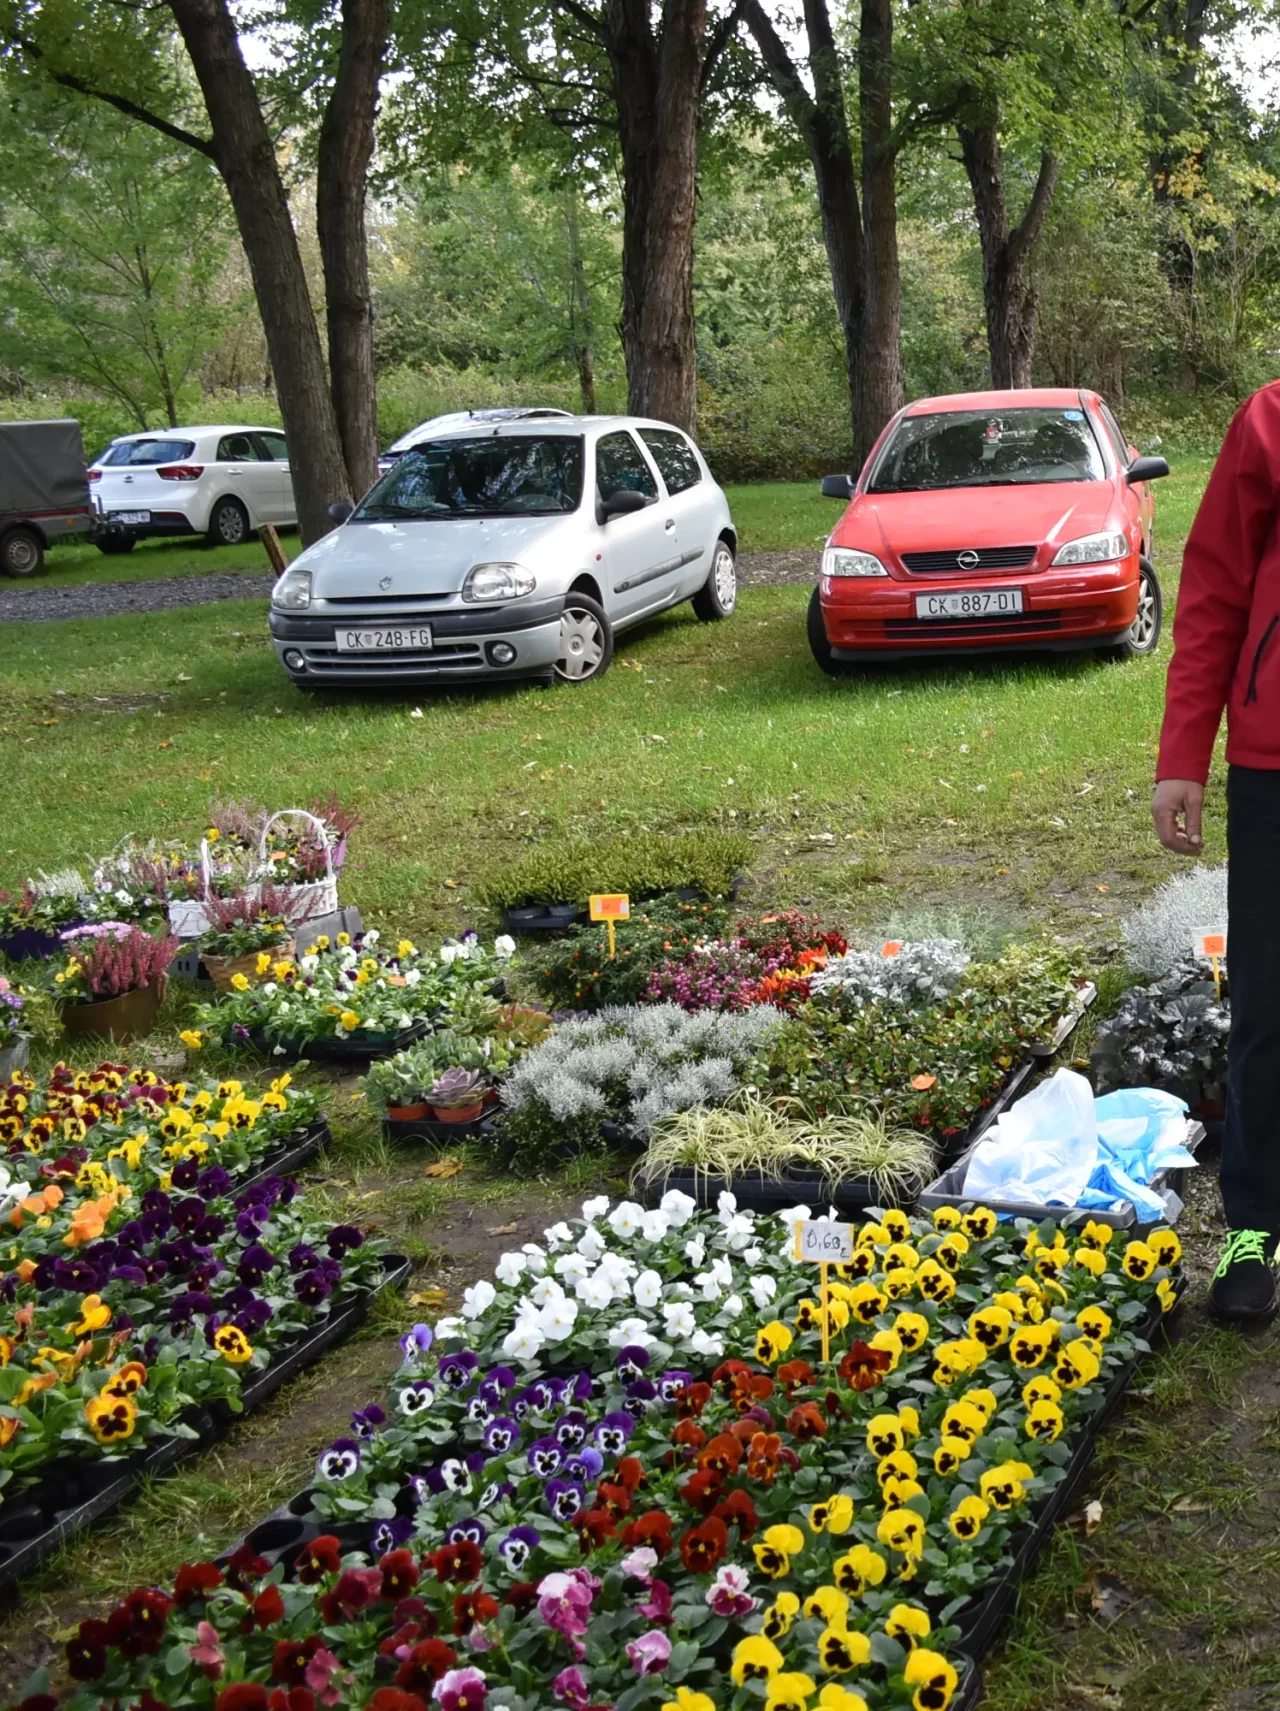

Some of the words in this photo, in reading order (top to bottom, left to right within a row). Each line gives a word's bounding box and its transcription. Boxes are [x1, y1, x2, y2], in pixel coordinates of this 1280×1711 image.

[928, 597, 948, 614] CK
[961, 593, 1016, 612] 887-DI
[346, 631, 364, 648] CK
[374, 629, 429, 647] 248-FG
